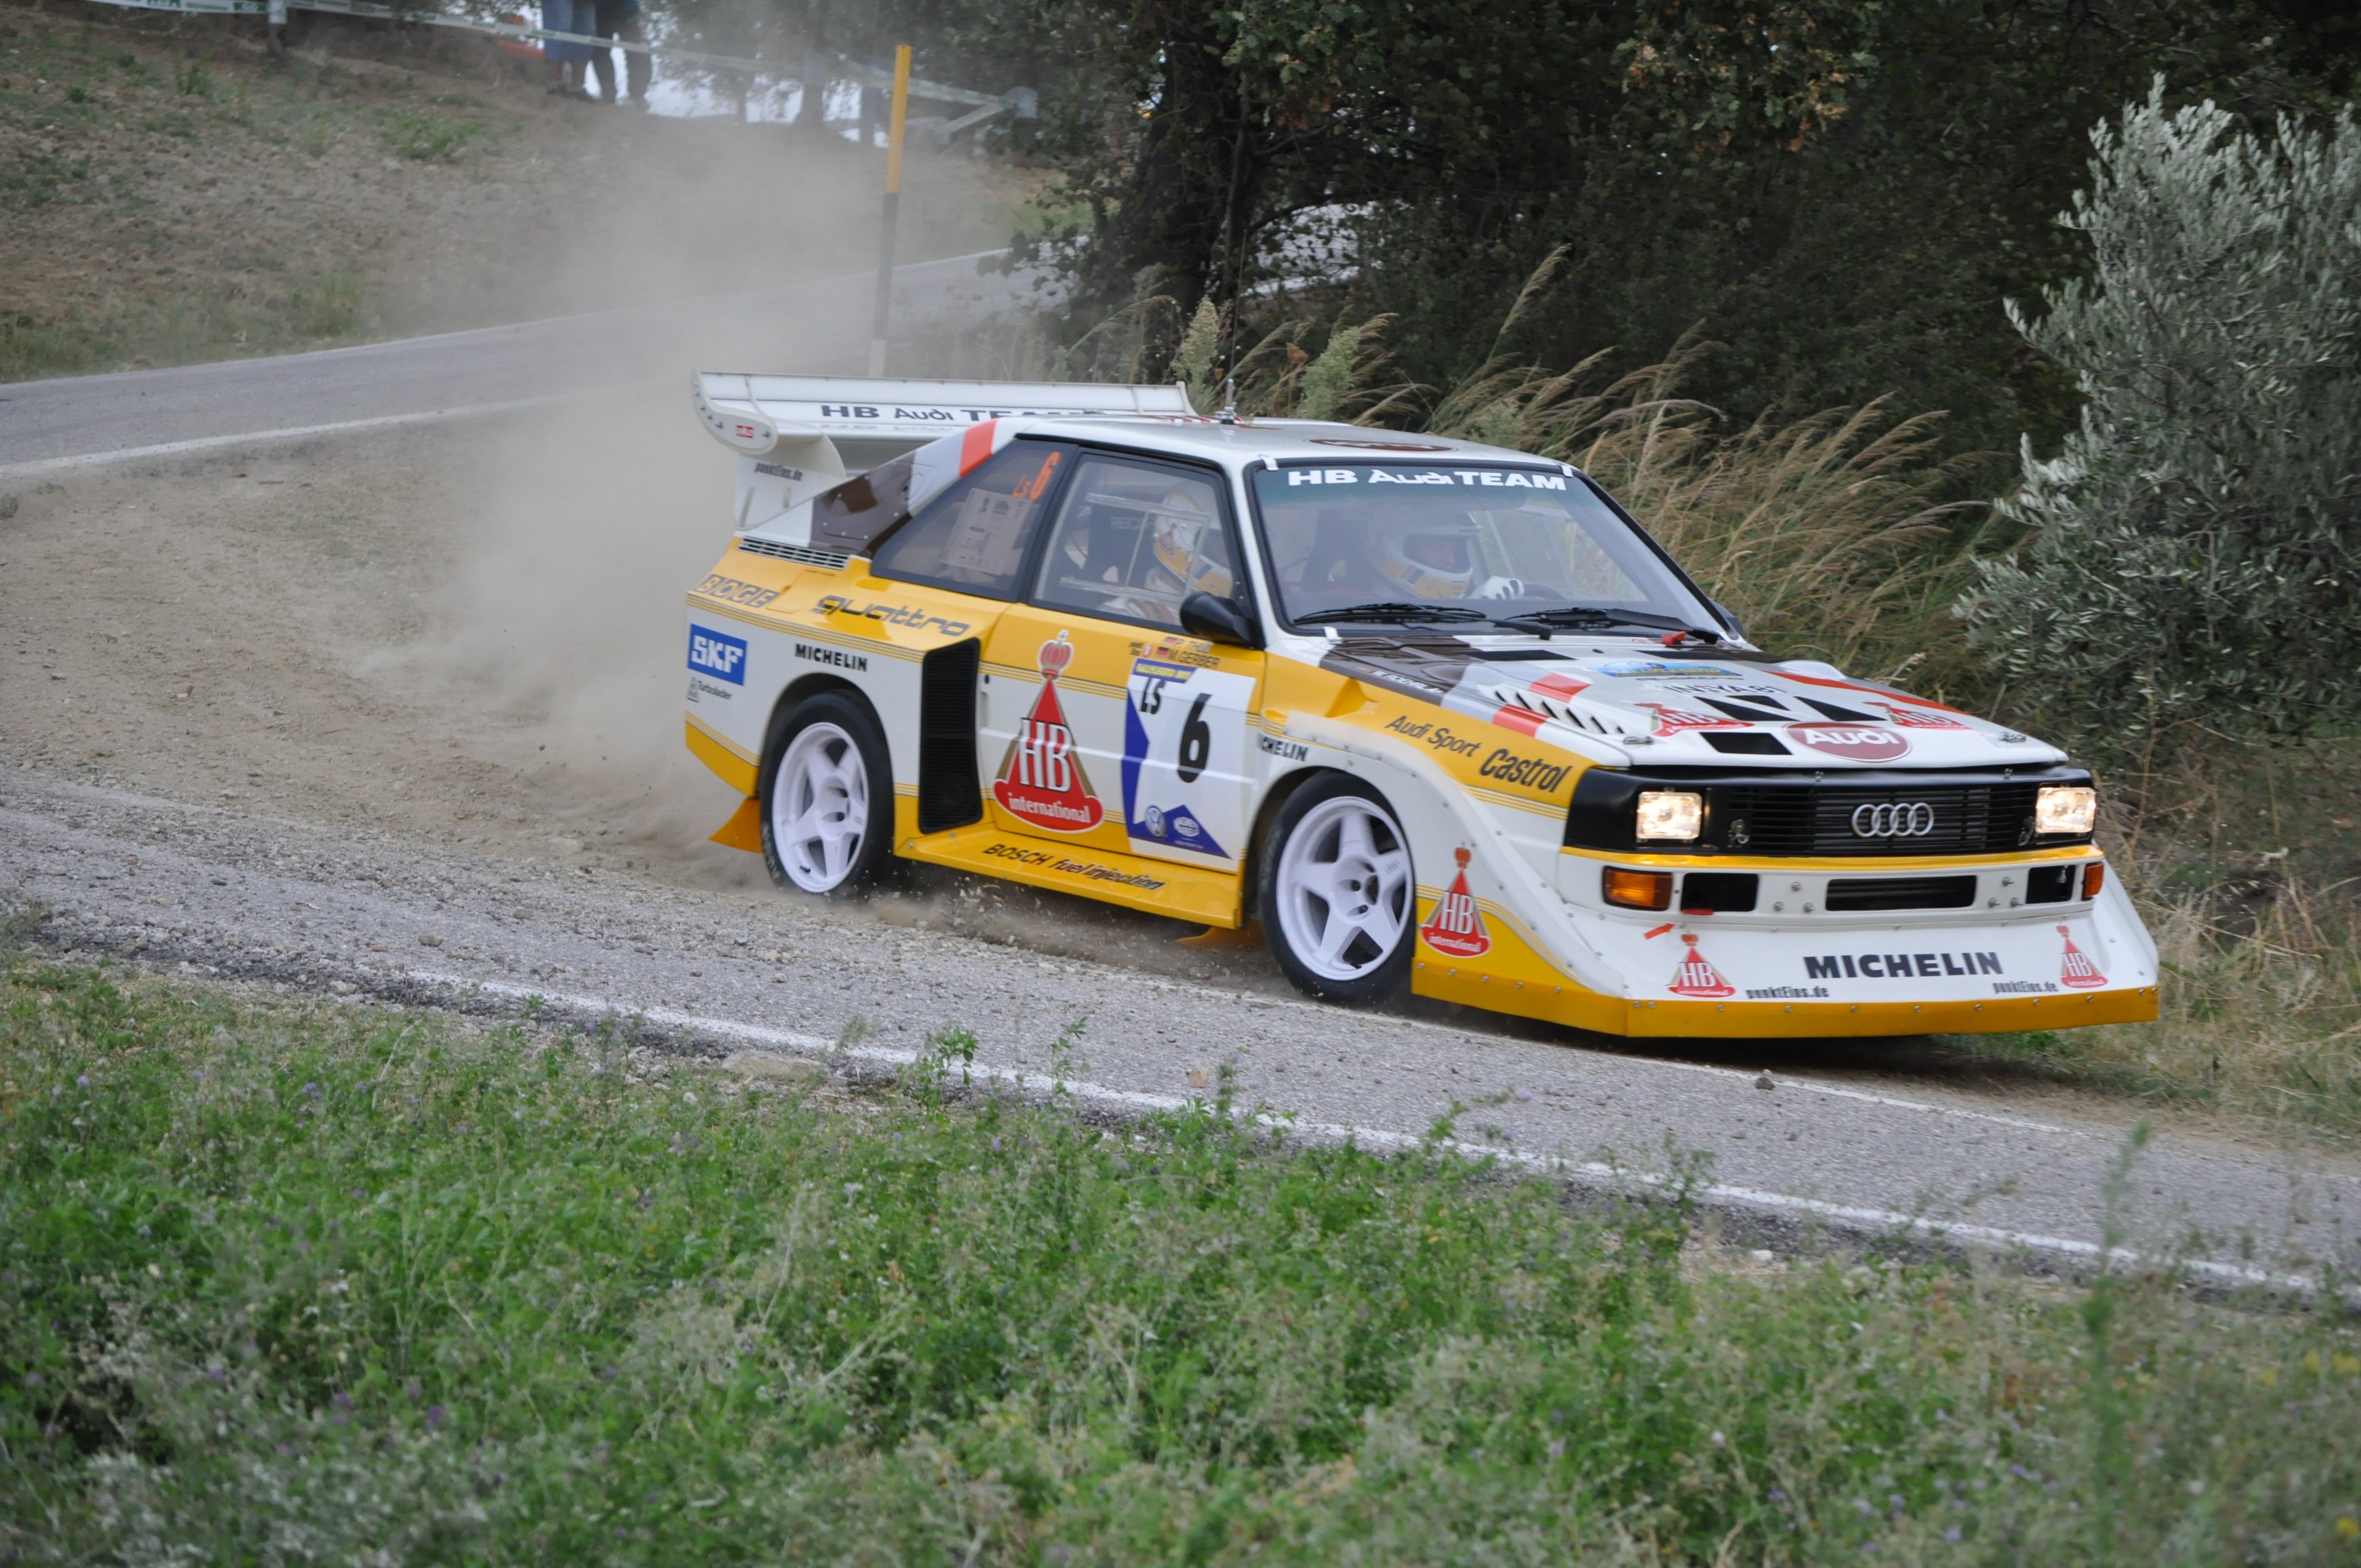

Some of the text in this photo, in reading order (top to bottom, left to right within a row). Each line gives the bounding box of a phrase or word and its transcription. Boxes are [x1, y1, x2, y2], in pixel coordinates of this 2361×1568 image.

[820, 405, 879, 418] HB
[894, 407, 954, 421] Audi
[1029, 451, 1062, 501] 6
[1288, 469, 1567, 491] HB Audi TEAM
[695, 575, 776, 607] BOGE
[810, 595, 971, 637] quattro
[691, 634, 743, 673] SKF
[795, 643, 868, 673] MICHELIN
[1140, 678, 1166, 715] LS
[1020, 717, 1072, 793] HB
[1177, 692, 1213, 783] 6
[1385, 716, 1482, 758] Audi Sport
[1803, 728, 1900, 745] Audi
[1479, 748, 1574, 793] Castrol
[1008, 792, 1092, 824] international
[982, 844, 1166, 890] BOSCH fuel injection
[1439, 890, 1475, 935] HB
[1678, 961, 1717, 987] HB
[1803, 952, 2004, 979] MICHELIN
[2061, 951, 2093, 977] HB
